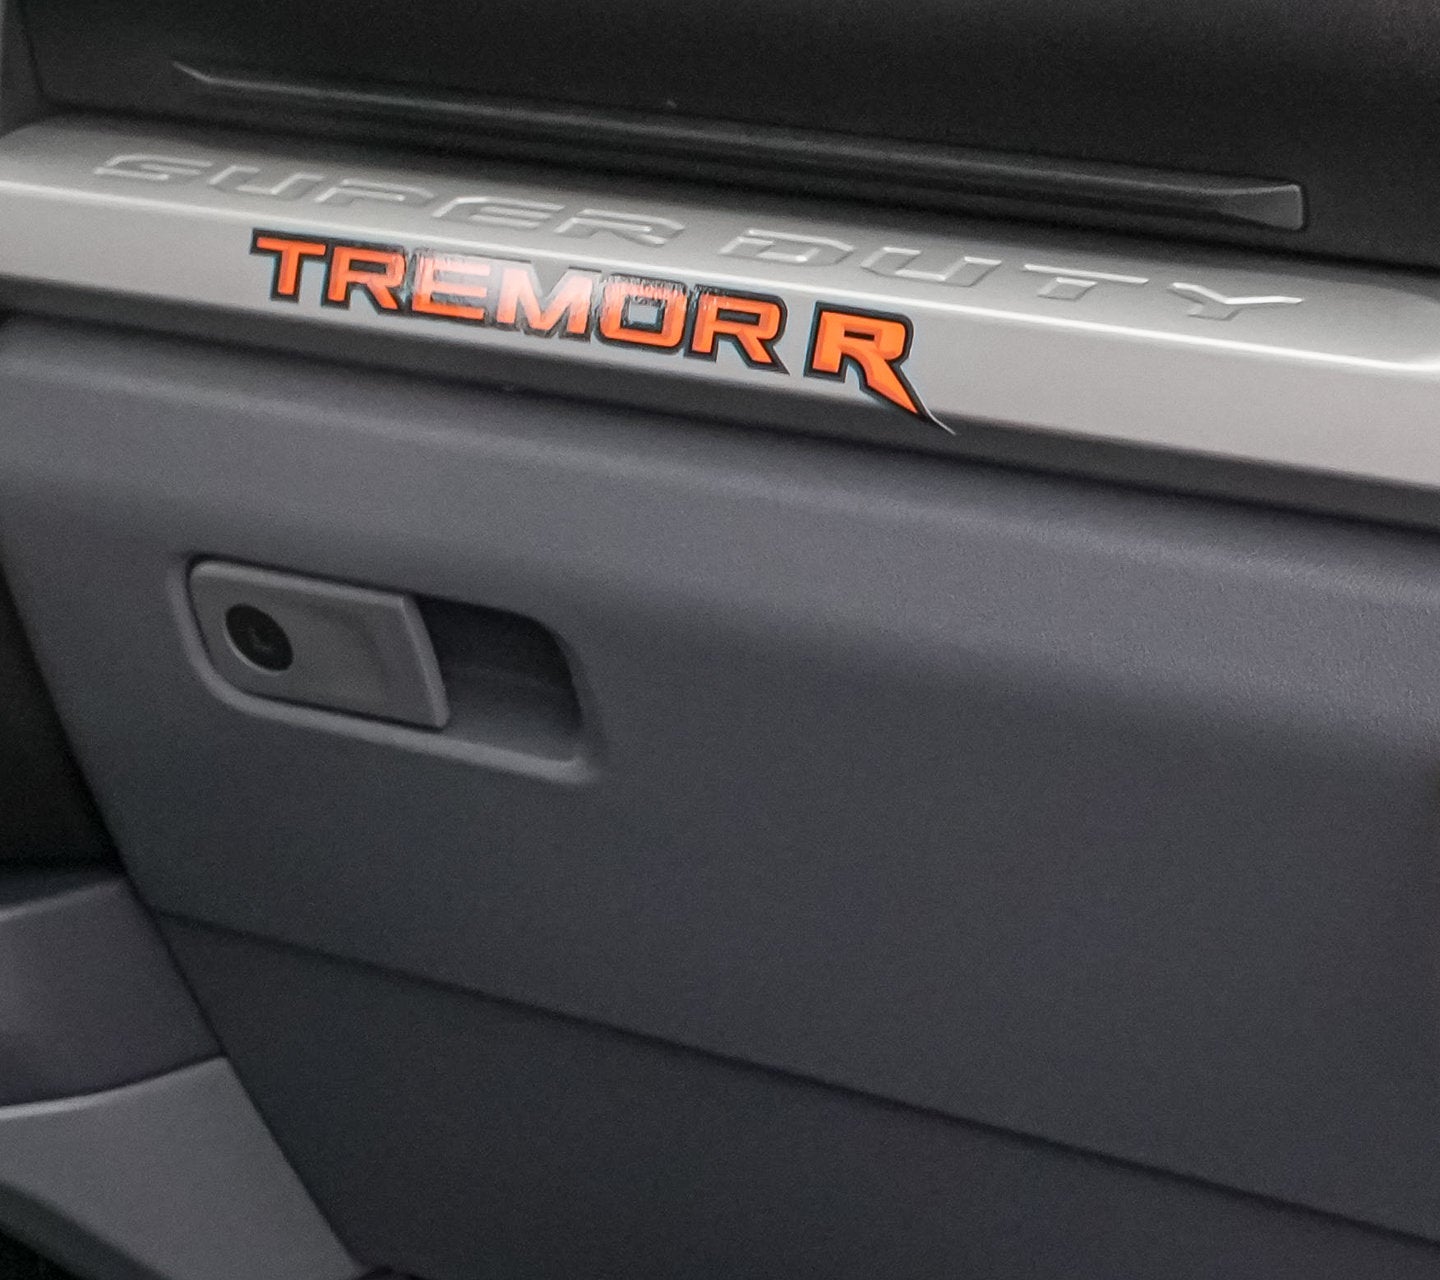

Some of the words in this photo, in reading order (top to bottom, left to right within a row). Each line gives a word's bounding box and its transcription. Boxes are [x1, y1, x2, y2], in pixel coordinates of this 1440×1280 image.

[93, 153, 687, 248] SUPER
[718, 228, 1304, 320] DUTY
[249, 228, 790, 376] TREMOR
[803, 300, 956, 434] R
